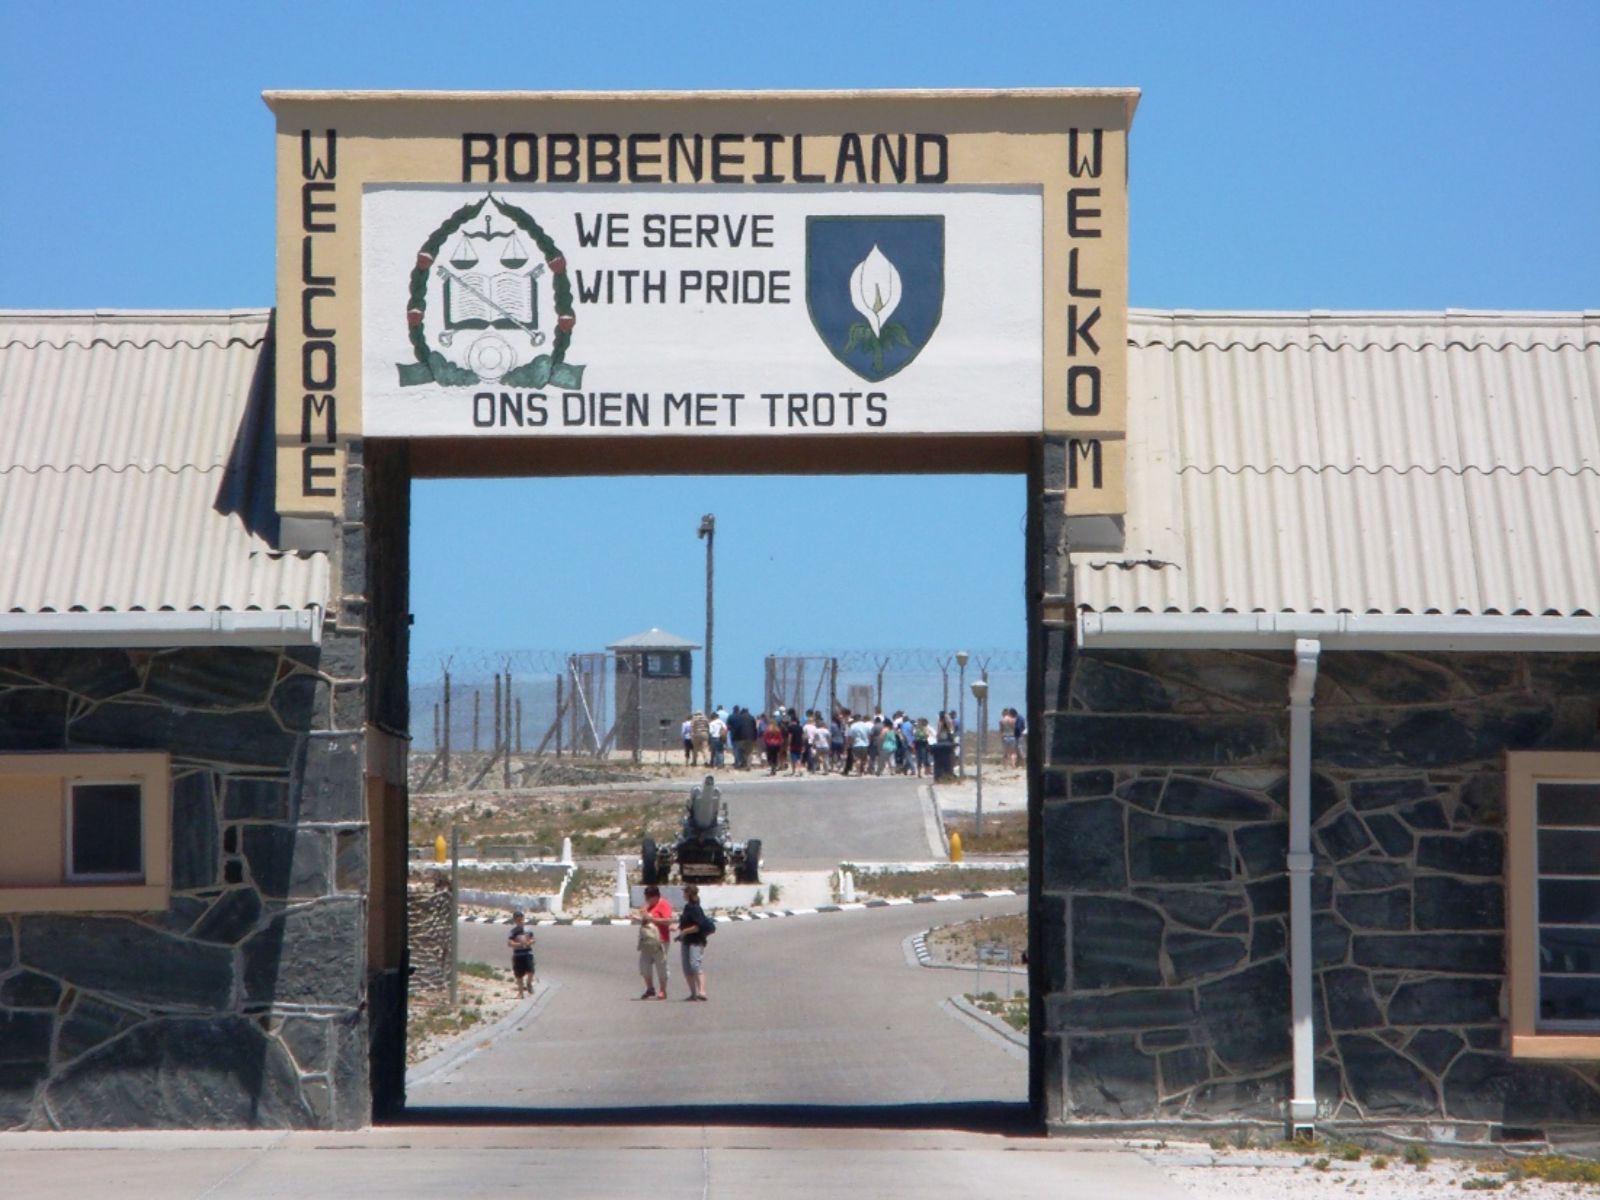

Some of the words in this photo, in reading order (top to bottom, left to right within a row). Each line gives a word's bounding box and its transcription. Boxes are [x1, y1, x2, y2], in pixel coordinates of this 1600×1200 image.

[461, 132, 949, 183] ROBBENEILAND
[575, 213, 629, 247] WE
[643, 214, 774, 247] SERVE
[576, 270, 666, 303] WITH
[681, 270, 791, 303] PRIDE
[1067, 128, 1102, 488] WELKOM
[301, 129, 336, 497] WELCOME
[473, 393, 548, 427] ONS
[562, 393, 649, 427] DIEN
[665, 393, 745, 427] MET
[761, 392, 887, 427] TROTS
